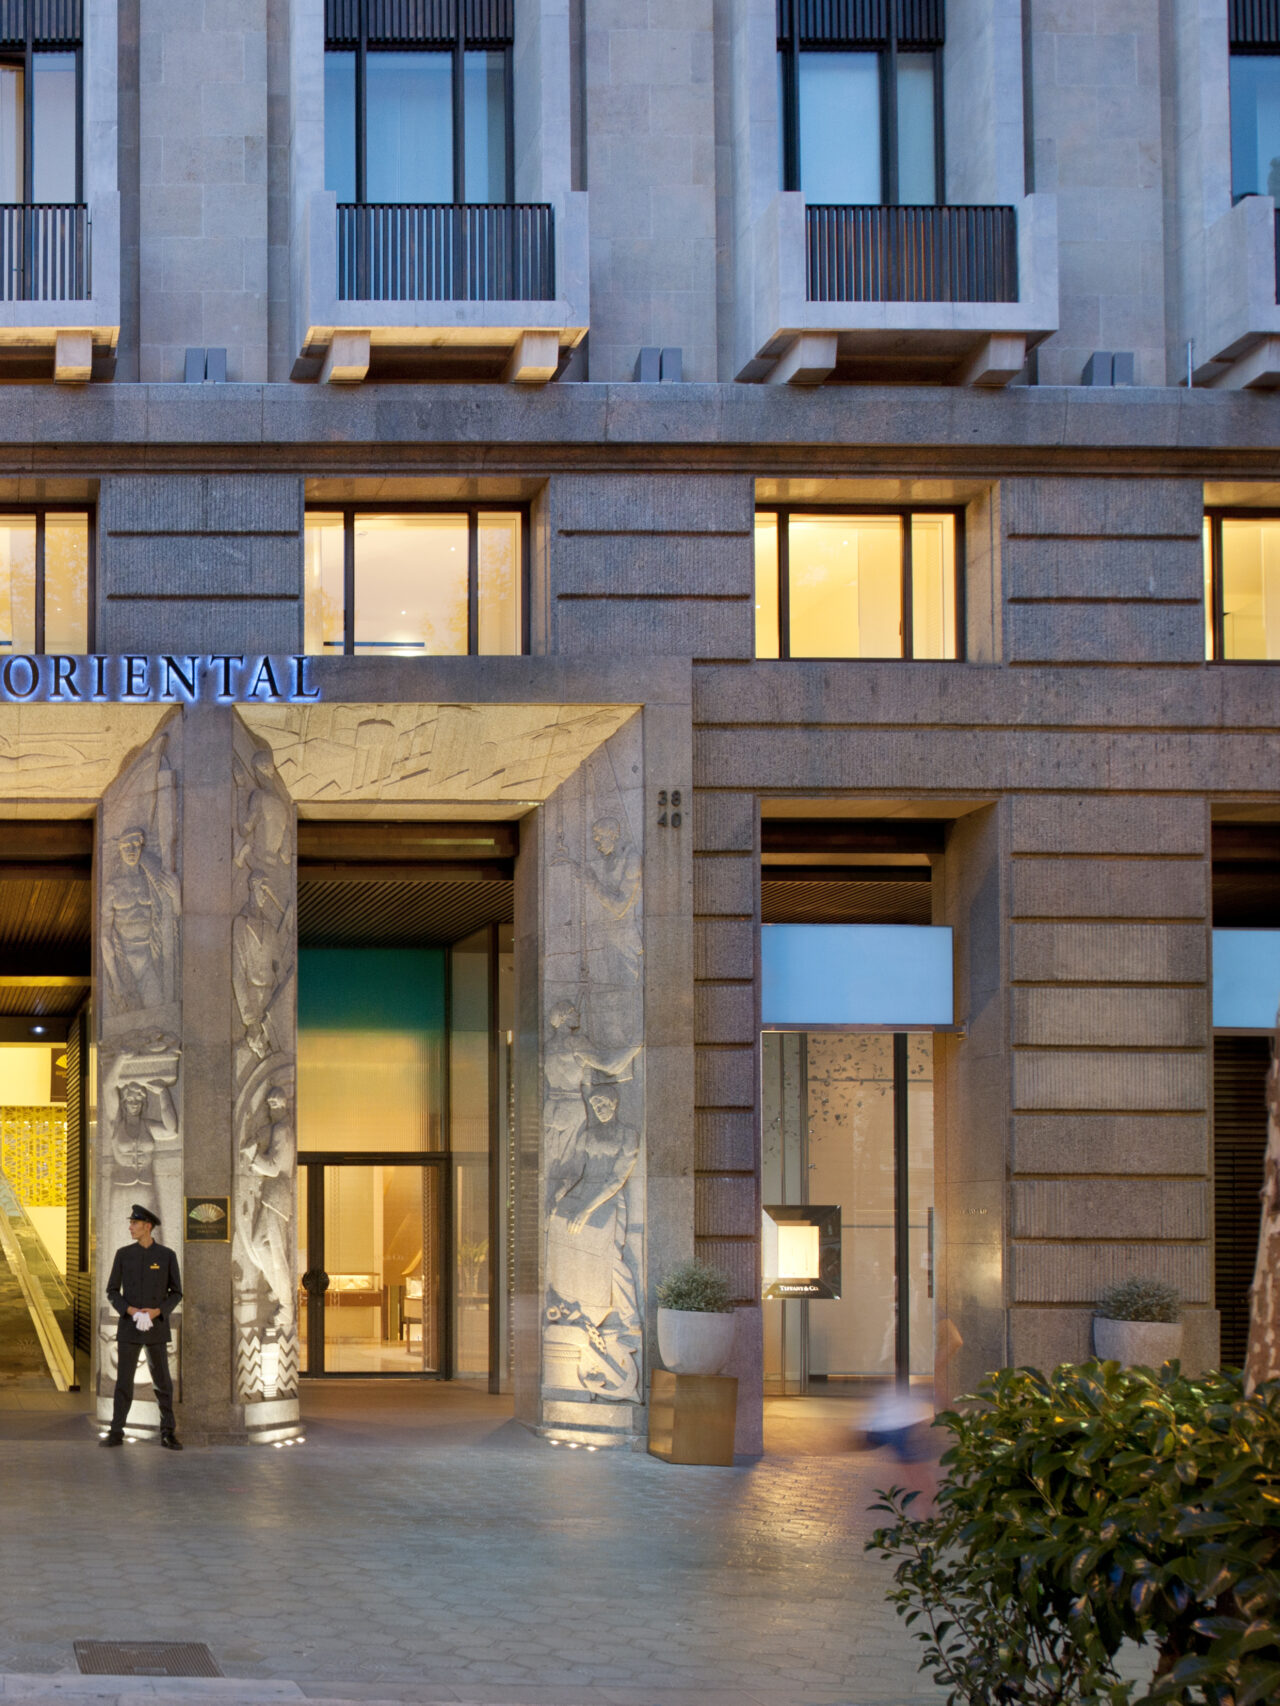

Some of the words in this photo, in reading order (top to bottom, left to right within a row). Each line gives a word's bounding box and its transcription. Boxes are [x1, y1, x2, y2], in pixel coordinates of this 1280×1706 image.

[2, 655, 321, 699] ORIENTAL
[657, 790, 681, 807] 38
[657, 811, 681, 828] 40
